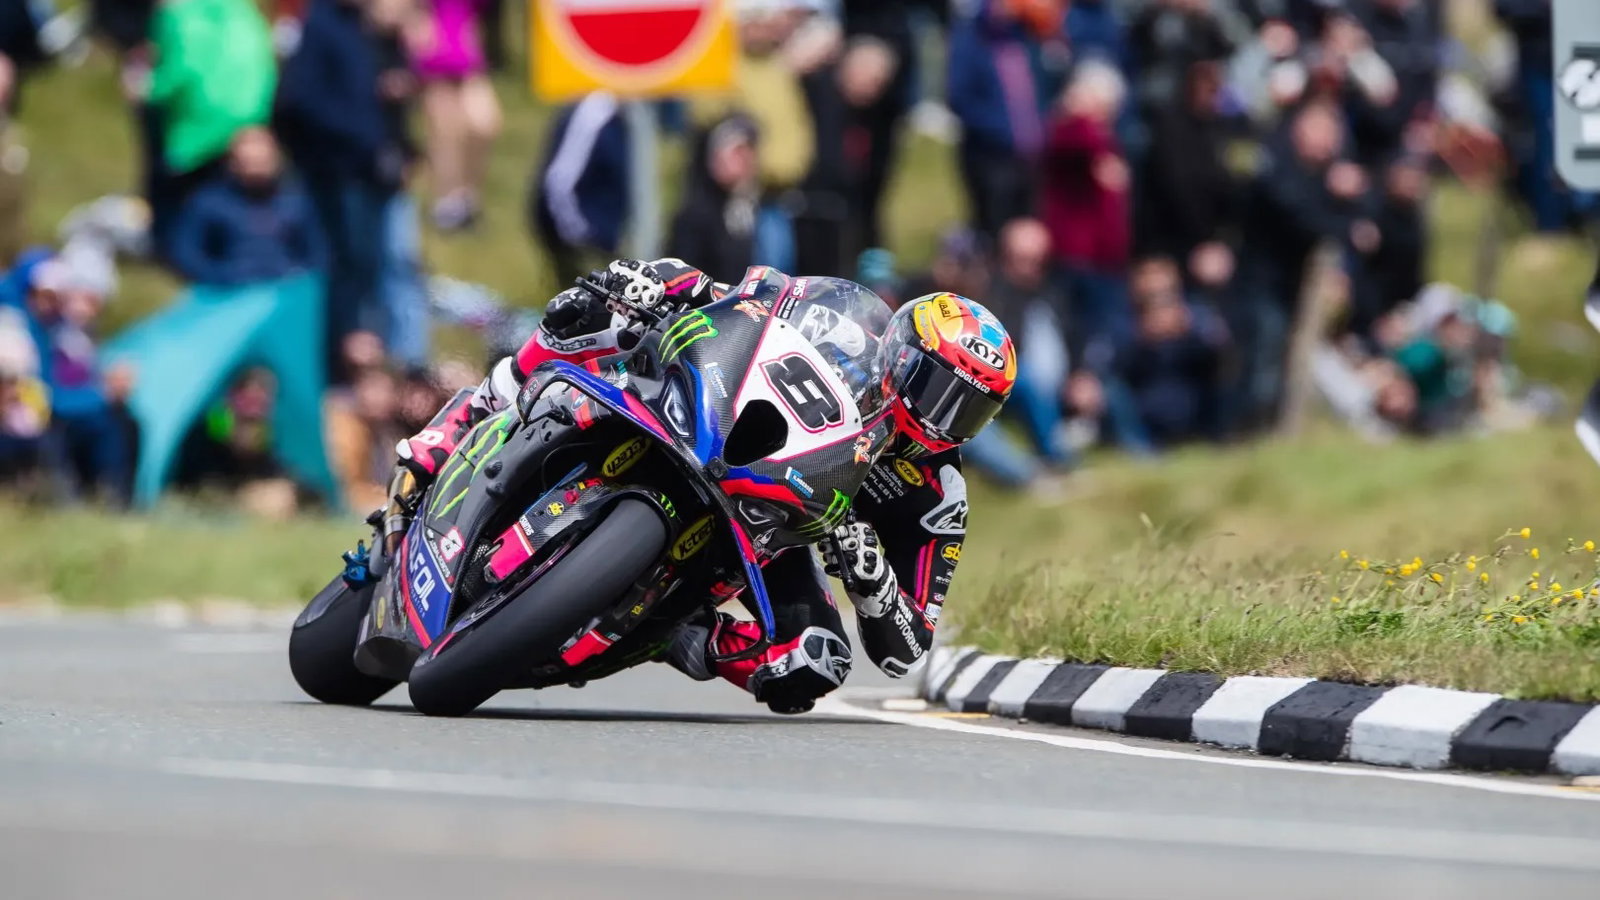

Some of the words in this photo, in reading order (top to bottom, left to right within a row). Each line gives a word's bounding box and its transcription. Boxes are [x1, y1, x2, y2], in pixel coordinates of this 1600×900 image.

[966, 338, 1004, 365] KYT
[873, 464, 895, 487] ROBOTS
[883, 465, 903, 488] GLOBAL
